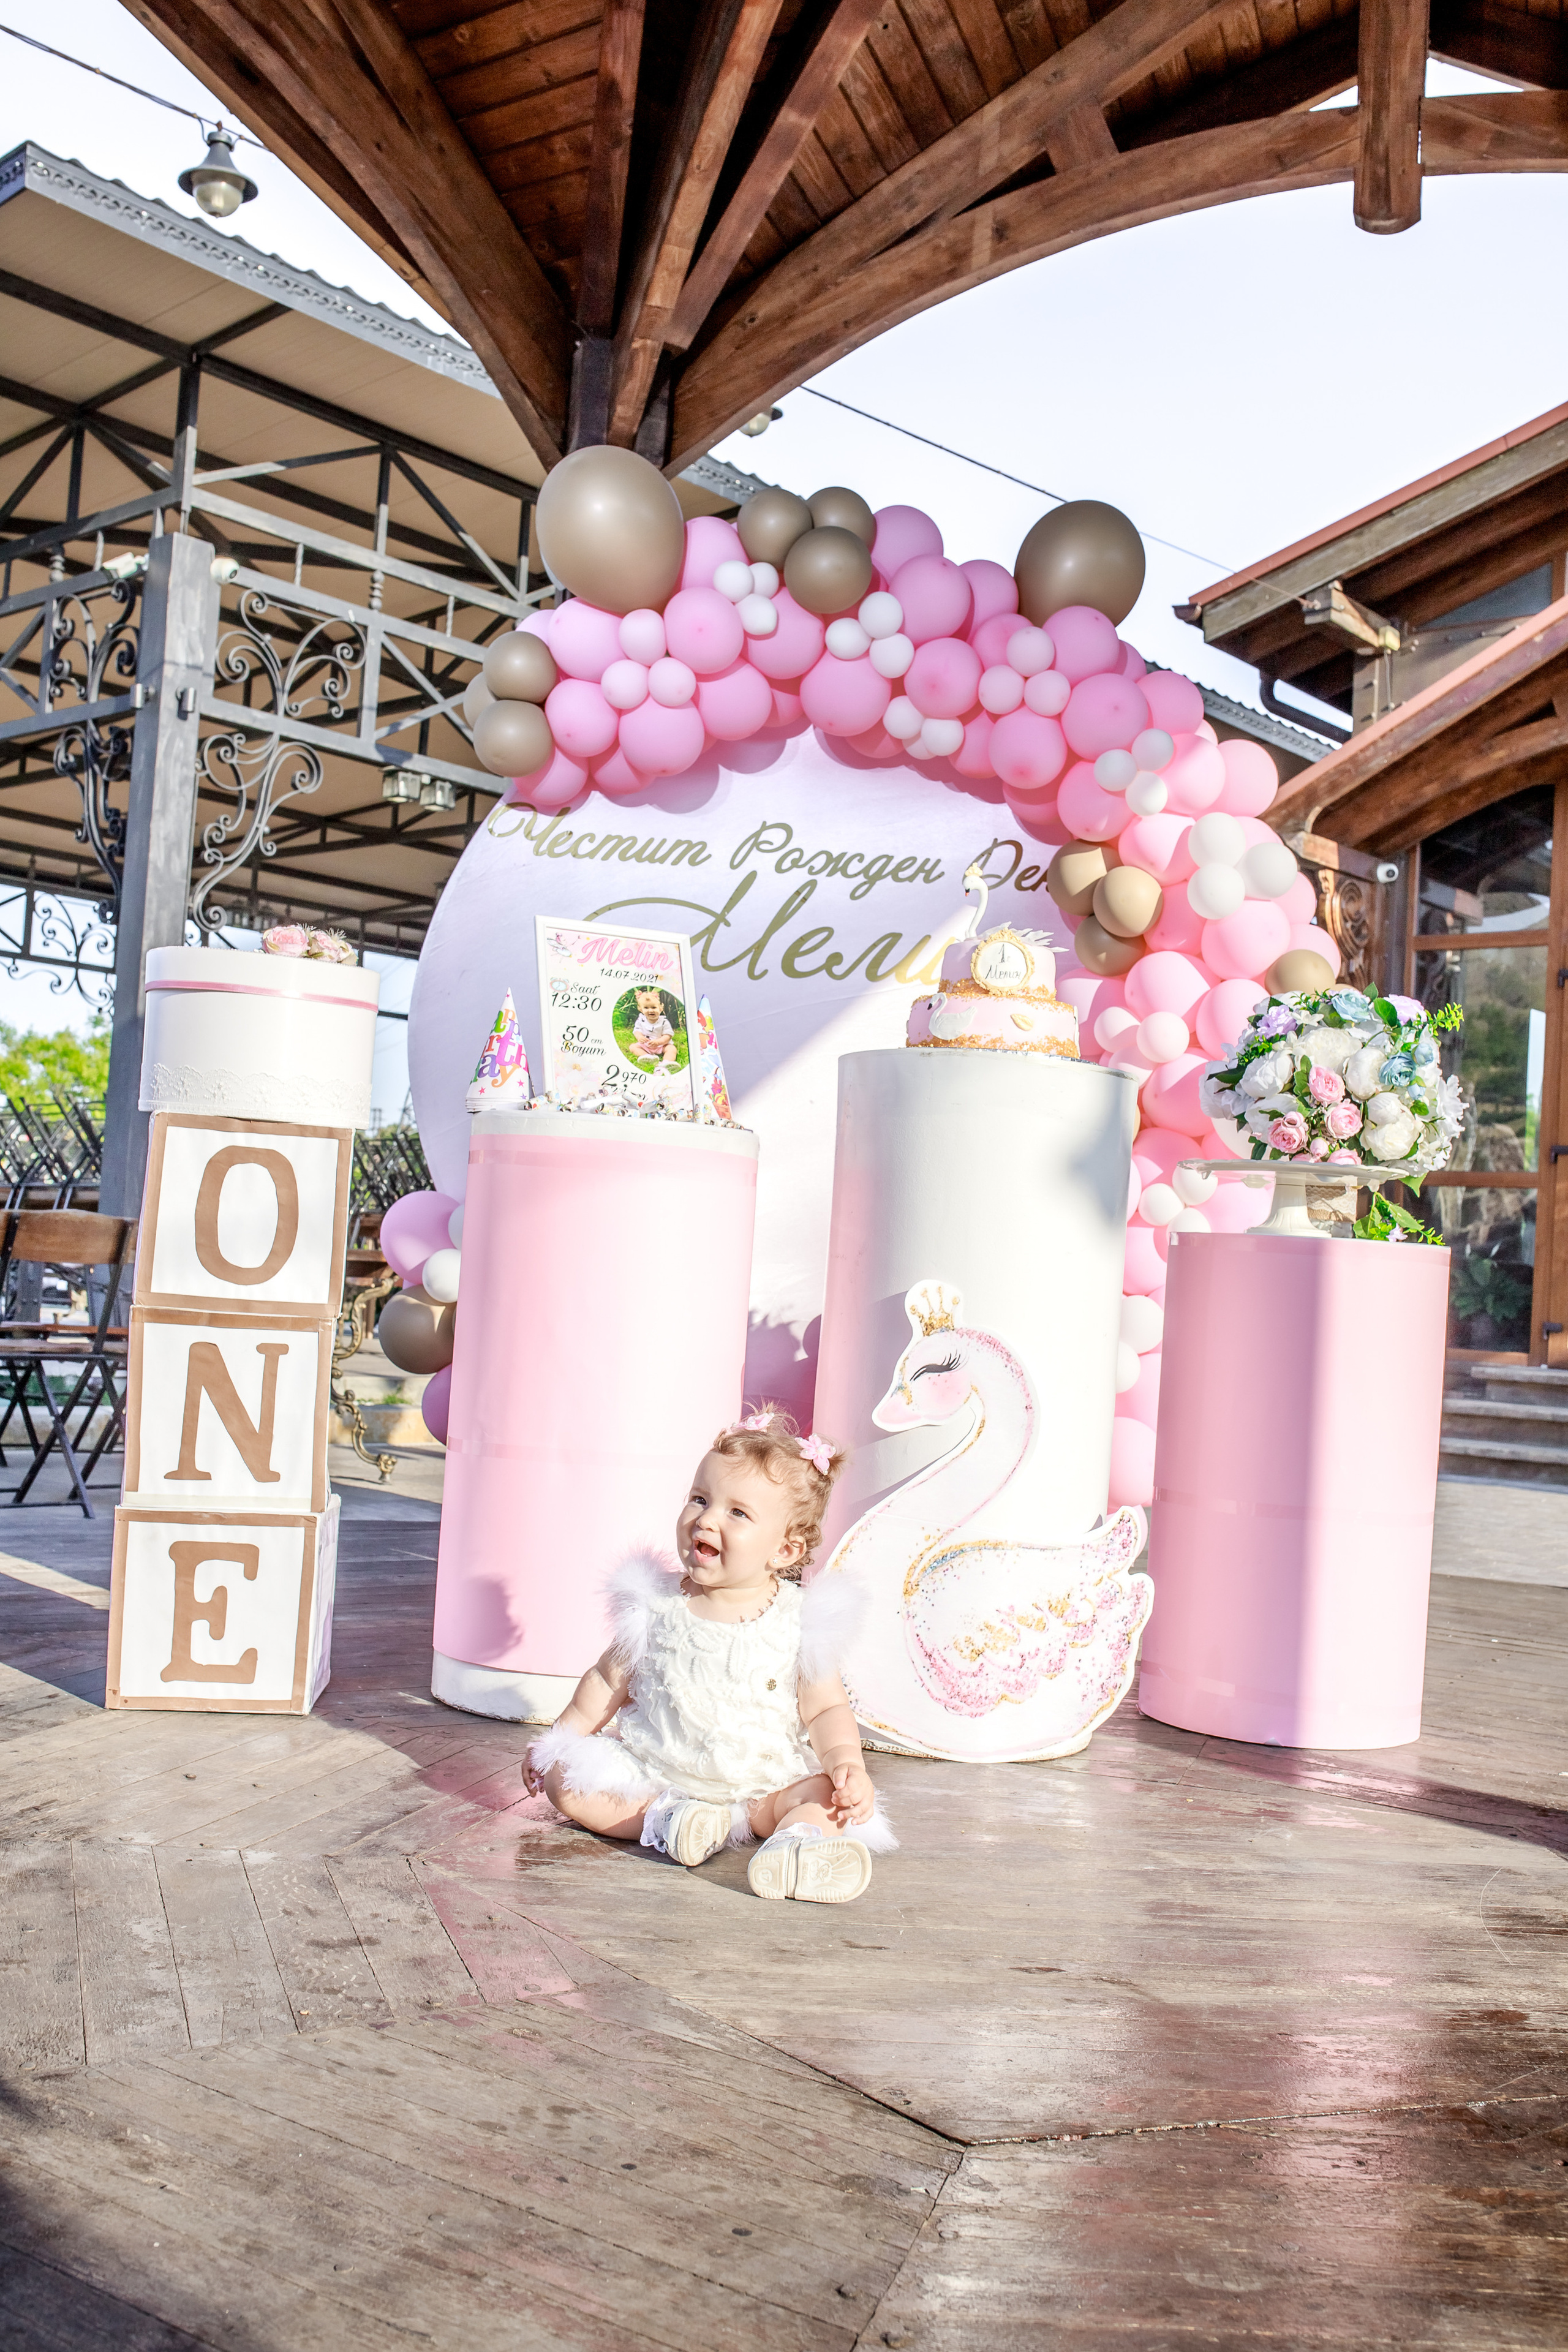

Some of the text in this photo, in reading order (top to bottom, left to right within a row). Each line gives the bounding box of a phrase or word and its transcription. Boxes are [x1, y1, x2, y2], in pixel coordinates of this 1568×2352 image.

[488, 802, 1049, 900] Честит Рожден Де
[582, 870, 957, 985] Мели
[577, 937, 674, 971] Melin
[600, 968, 659, 983] 14.07.2021
[570, 982, 601, 995] Saat
[551, 992, 602, 1012] 12:30
[562, 1025, 589, 1043] 50
[560, 1041, 606, 1057] Boyum
